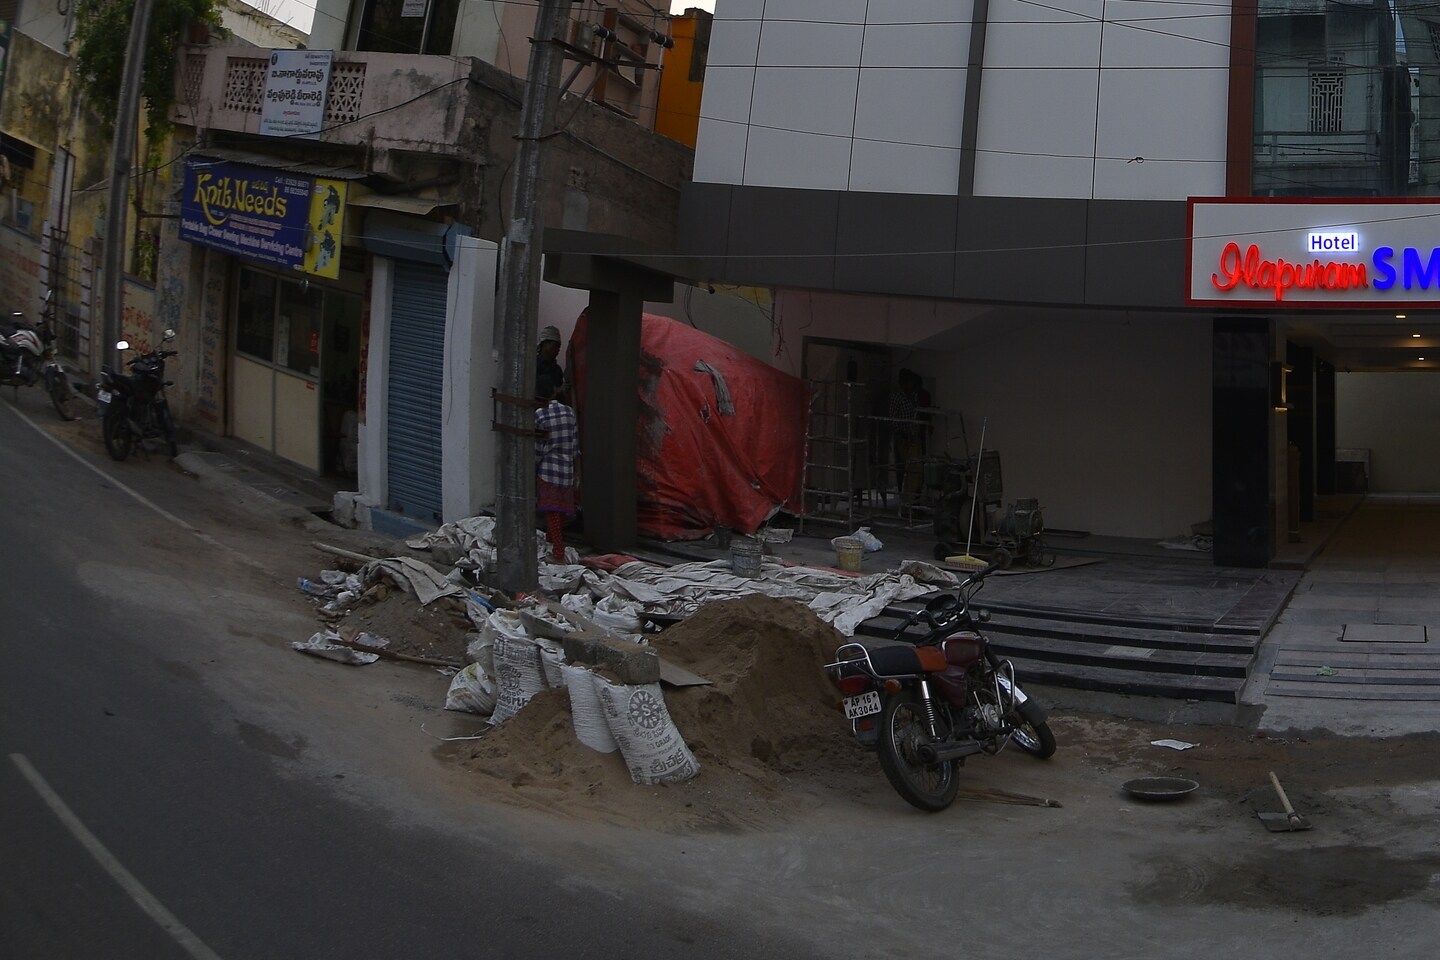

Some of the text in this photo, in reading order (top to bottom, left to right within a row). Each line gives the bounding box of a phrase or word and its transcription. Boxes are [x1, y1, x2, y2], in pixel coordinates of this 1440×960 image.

[193, 173, 232, 226] Knit
[232, 178, 288, 218] Needs
[1311, 234, 1356, 251] Hotel
[1212, 241, 1369, 302] Ilapuram
[851, 695, 871, 707] AP 16
[849, 703, 879, 718] AK3044
